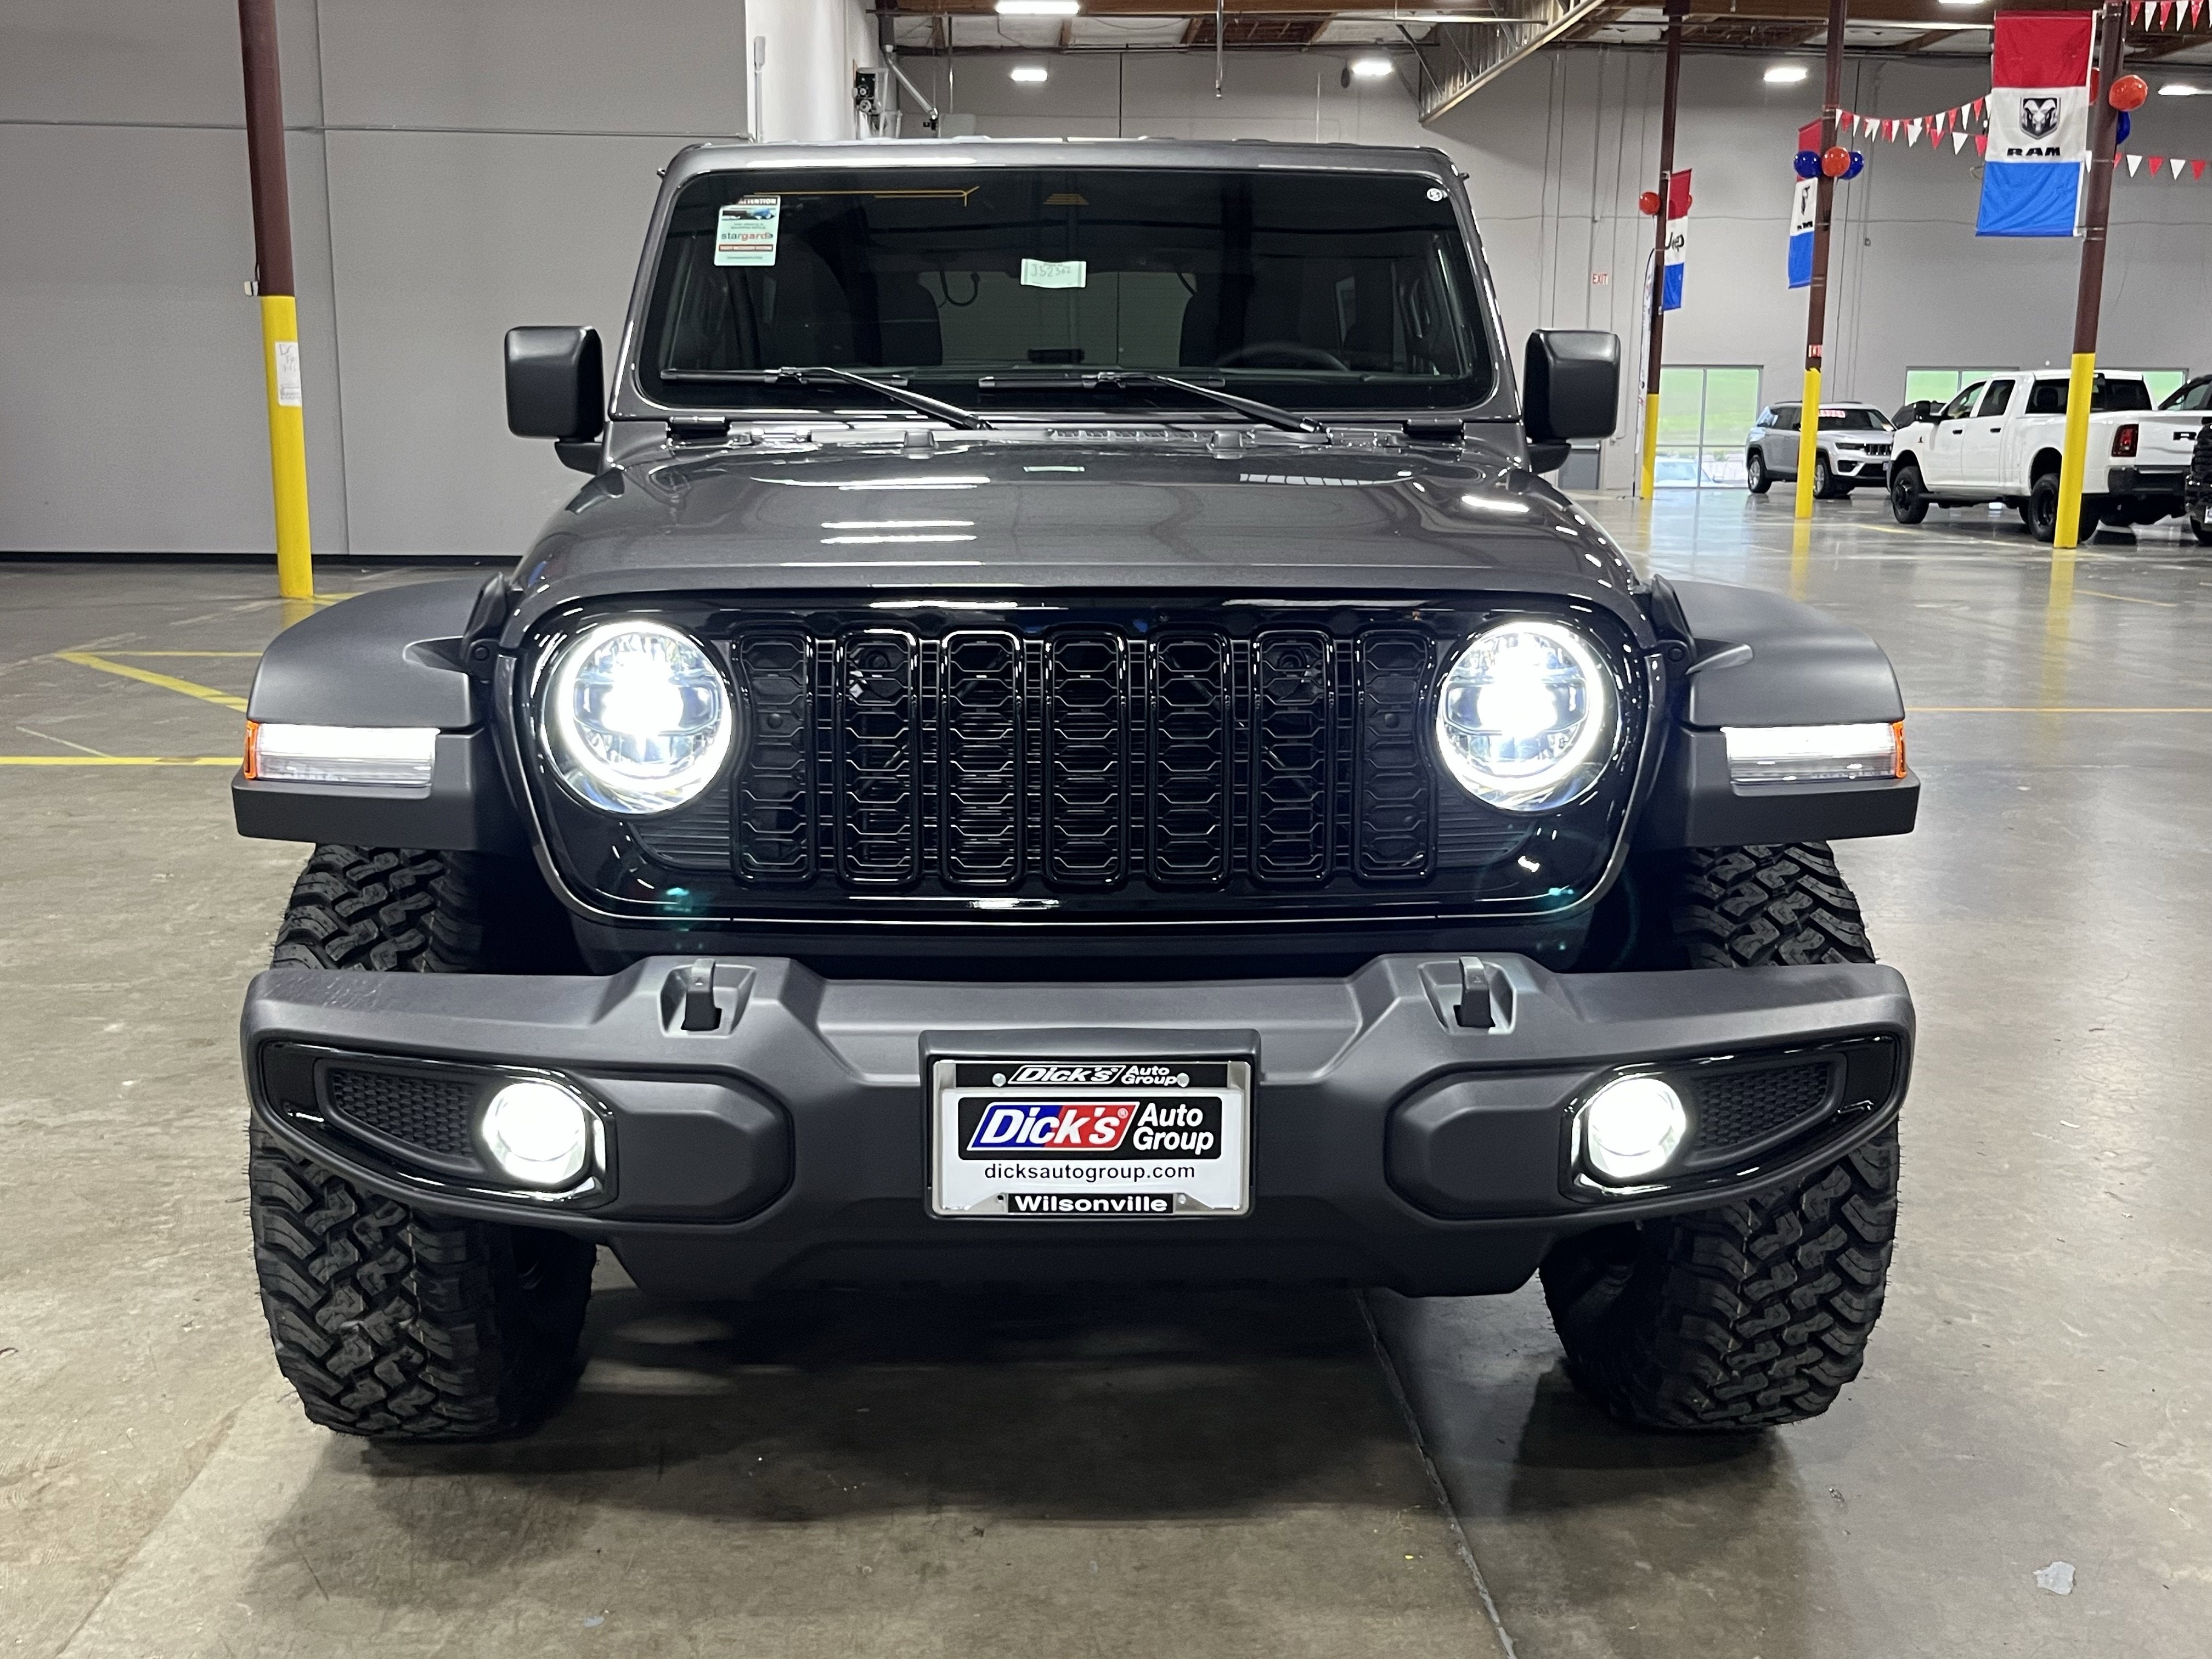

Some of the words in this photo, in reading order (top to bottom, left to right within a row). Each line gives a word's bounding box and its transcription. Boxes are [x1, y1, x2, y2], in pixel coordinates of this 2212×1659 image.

[2007, 146, 2061, 156] RAM
[1593, 274, 1607, 284] EXIT
[1126, 1065, 1170, 1075] Auto
[1121, 1075, 1177, 1086] Group
[1137, 1103, 1203, 1127] Auto
[1133, 1126, 1215, 1155] Group
[984, 1163, 1195, 1182] dicksautogroup.com
[1015, 1195, 1167, 1212] Wilsonville
